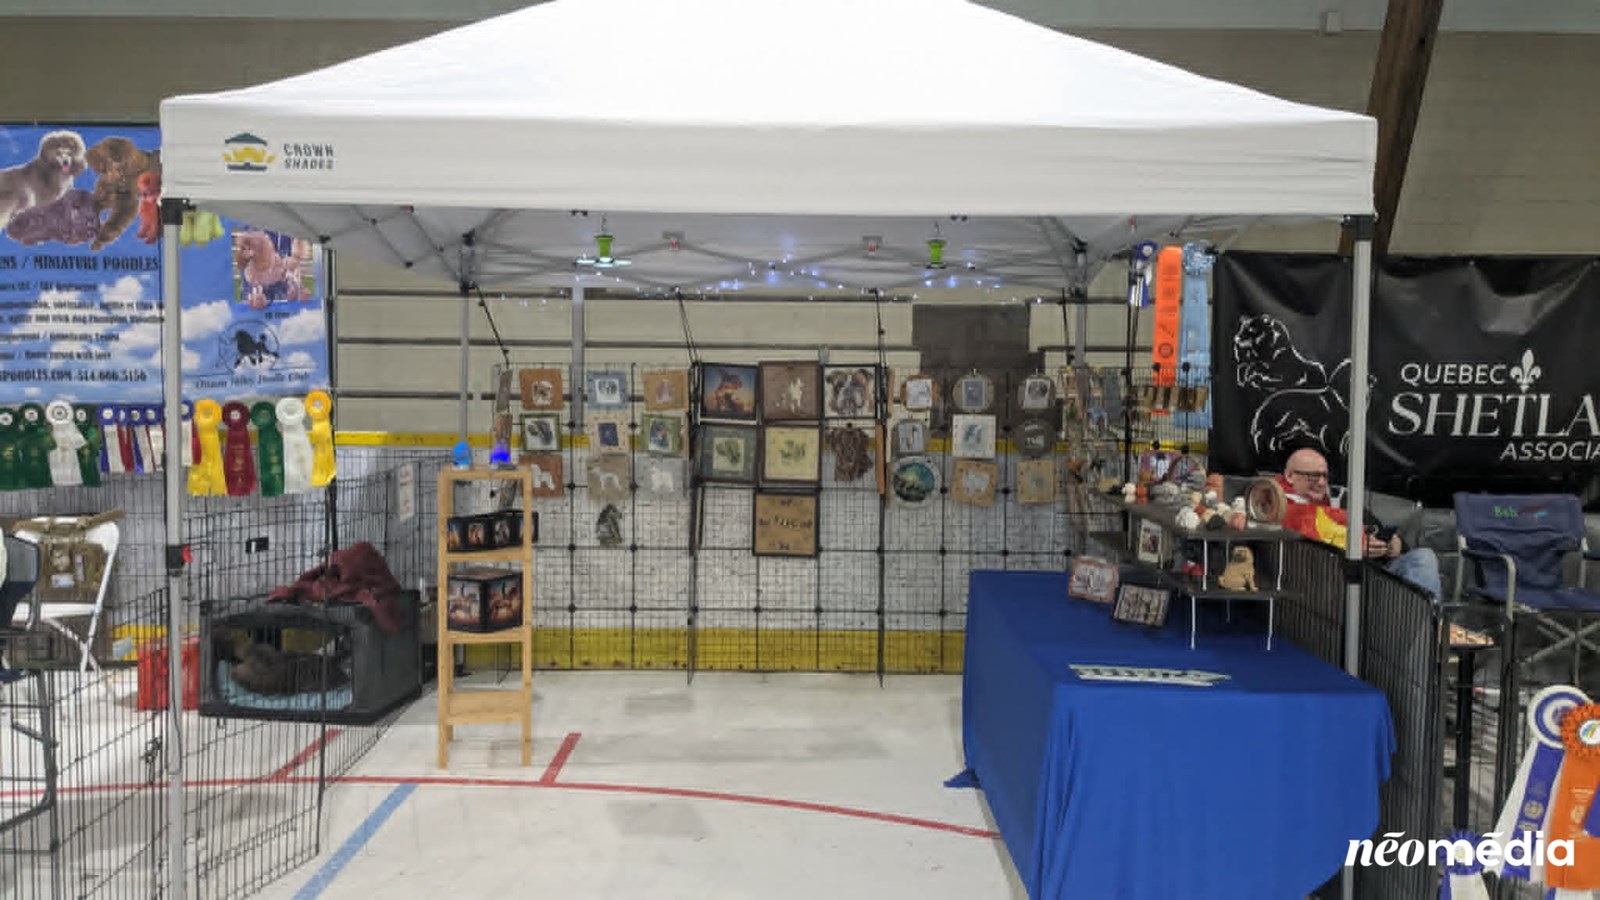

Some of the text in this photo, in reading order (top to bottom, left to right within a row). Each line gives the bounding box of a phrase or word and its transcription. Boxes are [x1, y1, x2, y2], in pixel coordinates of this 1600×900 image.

[283, 143, 335, 157] CROWN
[284, 159, 334, 170] SHADES
[34, 256, 97, 270] MINIATURE
[102, 256, 159, 270] POODLES
[1400, 362, 1508, 387] QUEBEC
[1388, 391, 1600, 437] SHETLA
